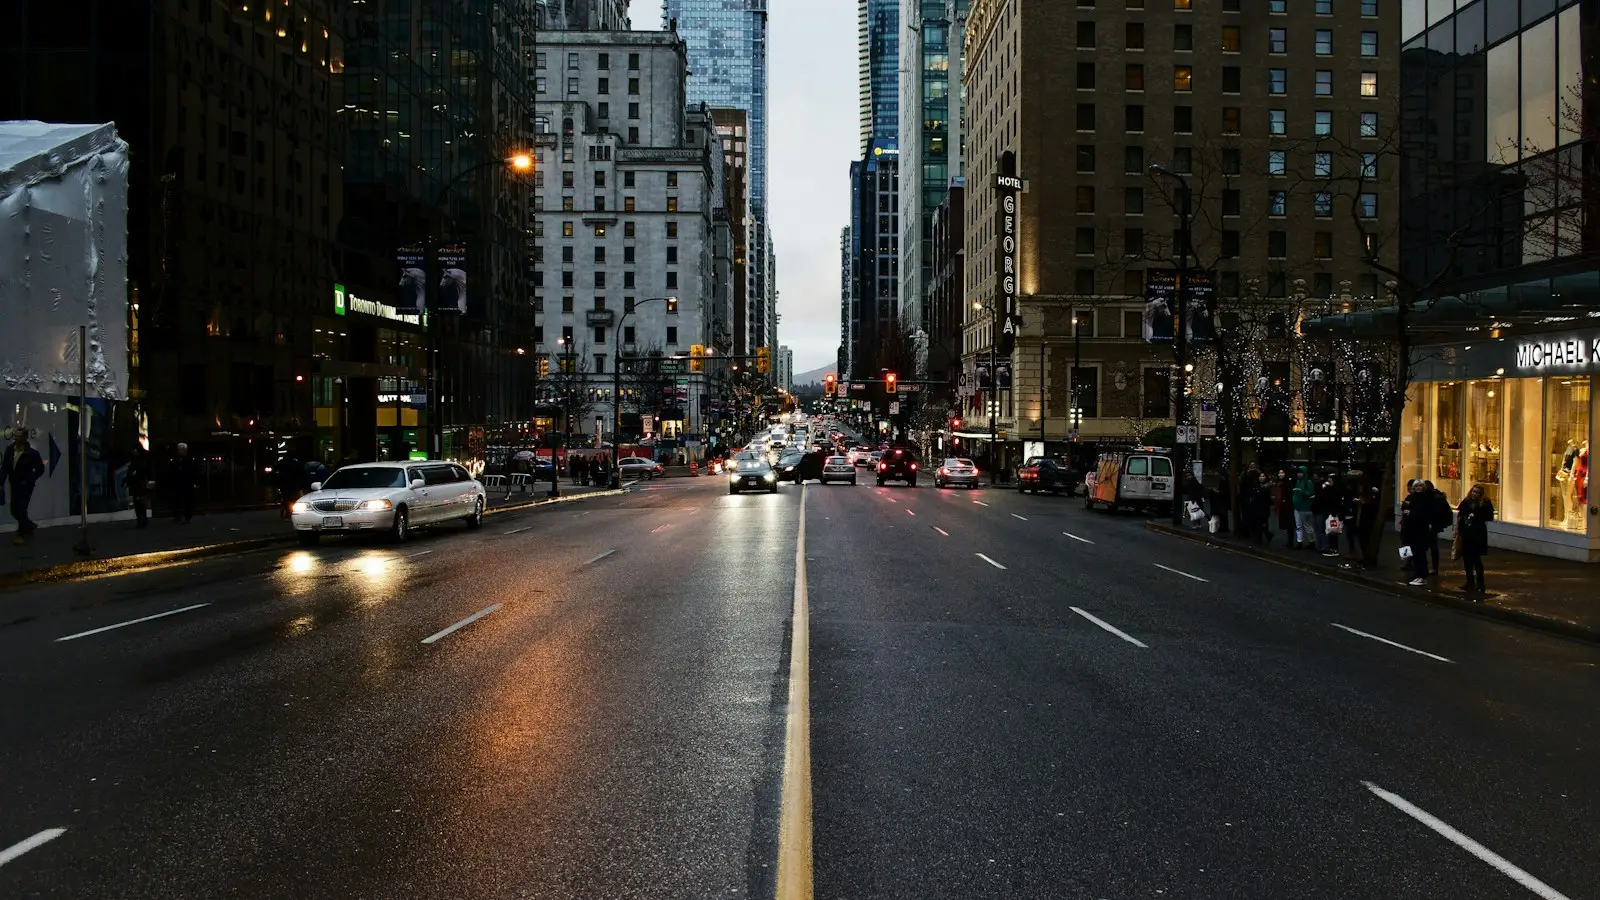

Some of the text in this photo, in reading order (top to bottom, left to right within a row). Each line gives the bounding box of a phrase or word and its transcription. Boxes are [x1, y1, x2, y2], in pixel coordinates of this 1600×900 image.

[998, 176, 1021, 189] HOTEL
[1003, 195, 1014, 334] GEORGIA
[349, 294, 376, 315] TORONTO
[1516, 341, 1583, 367] MICHAEL
[1304, 422, 1330, 433] HOT
